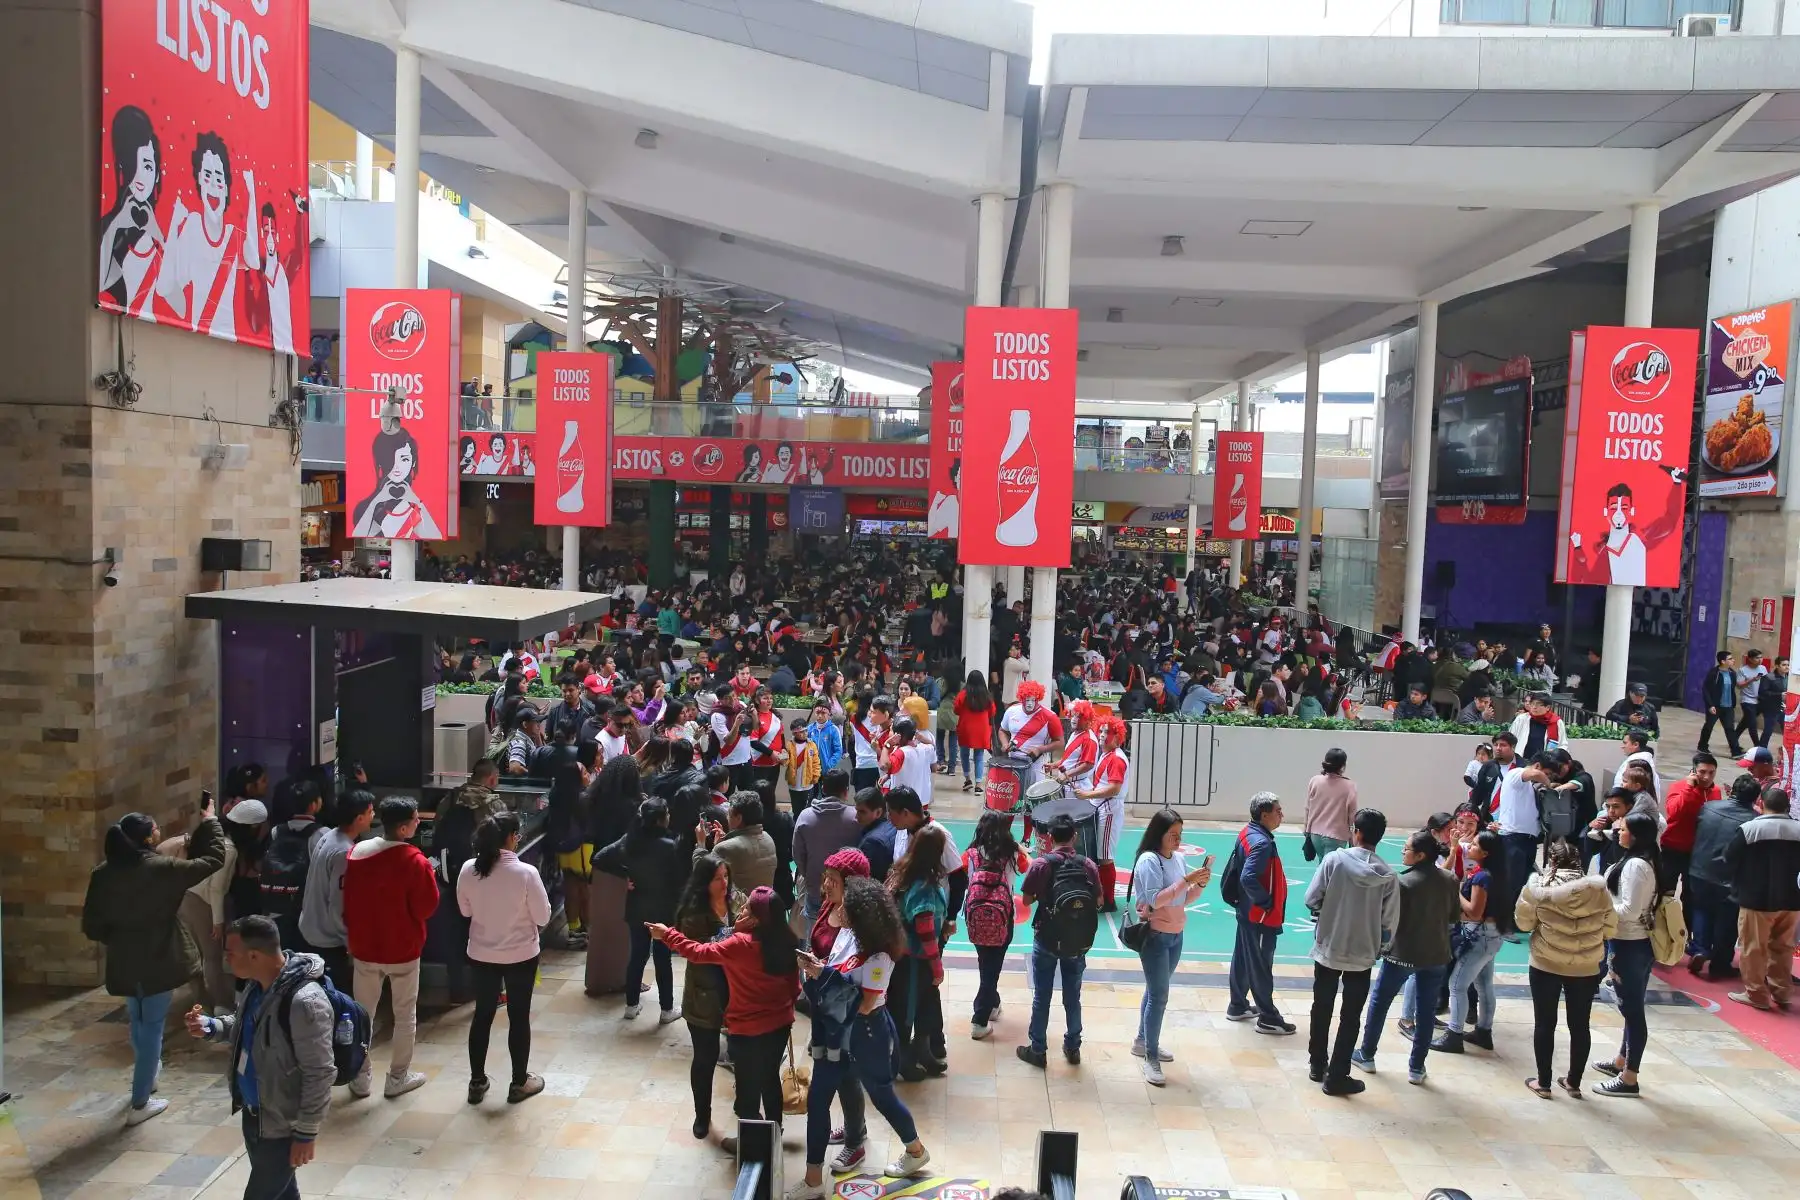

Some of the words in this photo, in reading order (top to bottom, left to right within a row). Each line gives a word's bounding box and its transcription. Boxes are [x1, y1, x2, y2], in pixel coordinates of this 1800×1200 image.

[156, 0, 270, 109] LISTOS
[993, 332, 1050, 355] TODOS
[1726, 336, 1767, 356] CHICKEN
[992, 358, 1050, 381] LISTOS
[1735, 355, 1754, 372] MIX
[370, 373, 424, 395] TODOS
[554, 368, 591, 384] TODOS
[553, 386, 591, 402] LISTOS
[370, 398, 424, 420] LIOS
[1607, 411, 1664, 435] TODOS
[1228, 441, 1253, 451] TODOS
[1604, 437, 1663, 461] LISTOS
[613, 448, 663, 470] ISTOS
[842, 455, 896, 478] TODOS
[1228, 453, 1252, 463] LISTOS
